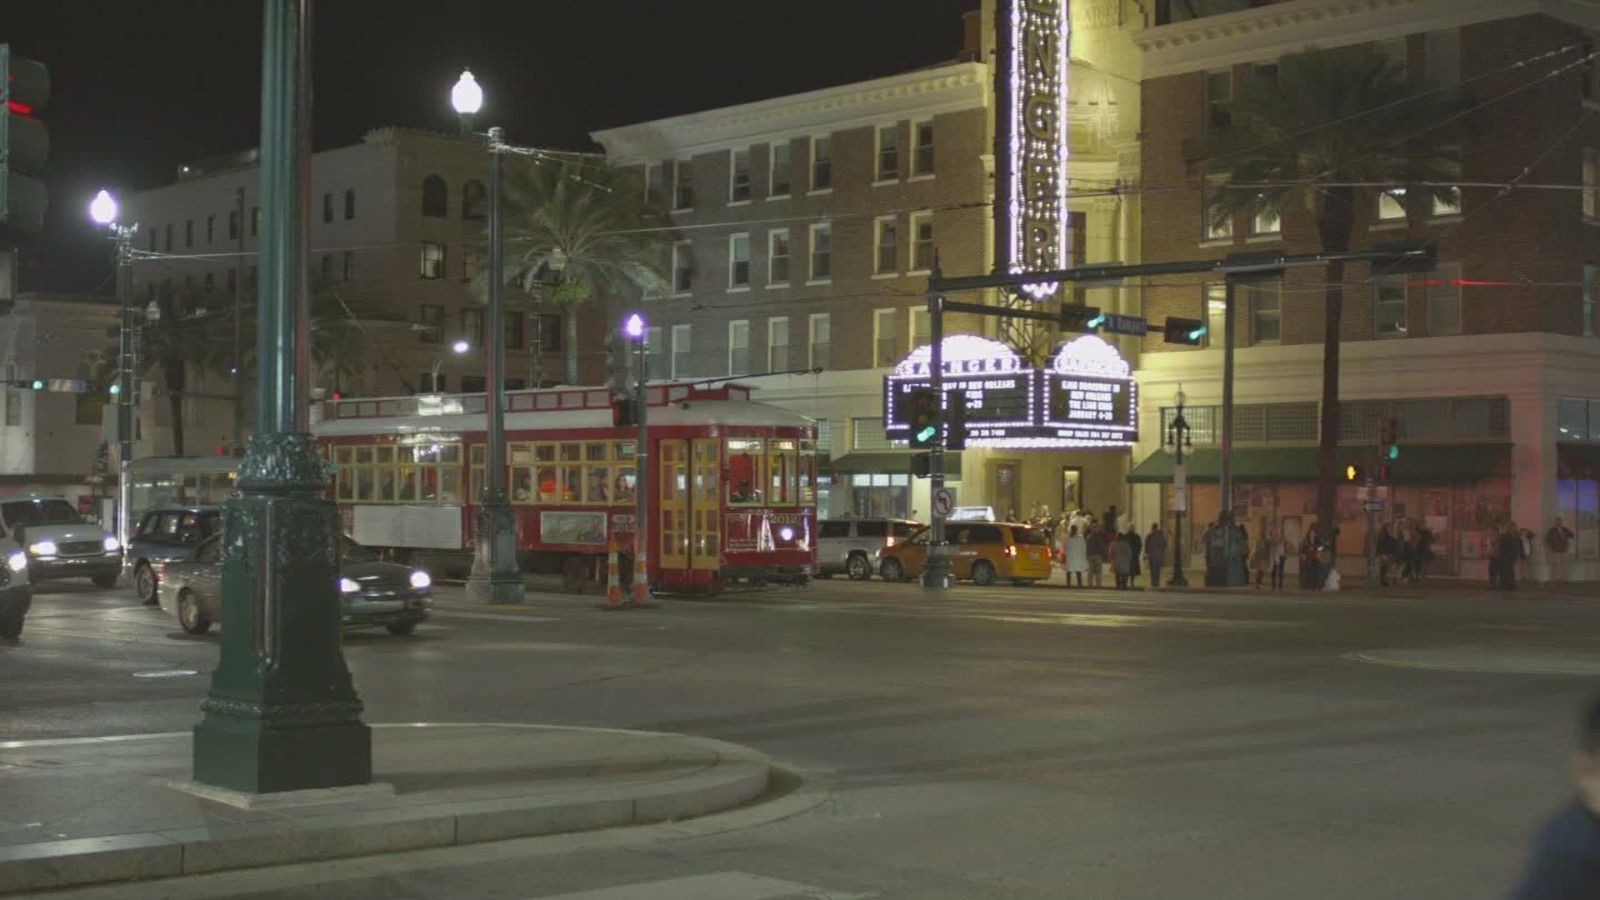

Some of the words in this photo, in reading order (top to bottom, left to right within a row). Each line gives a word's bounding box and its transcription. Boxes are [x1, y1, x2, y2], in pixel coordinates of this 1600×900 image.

[902, 358, 1013, 375] SANGER
[968, 381, 983, 390] NEW
[984, 380, 1015, 389] ORLEANS
[769, 515, 798, 524] 2012
